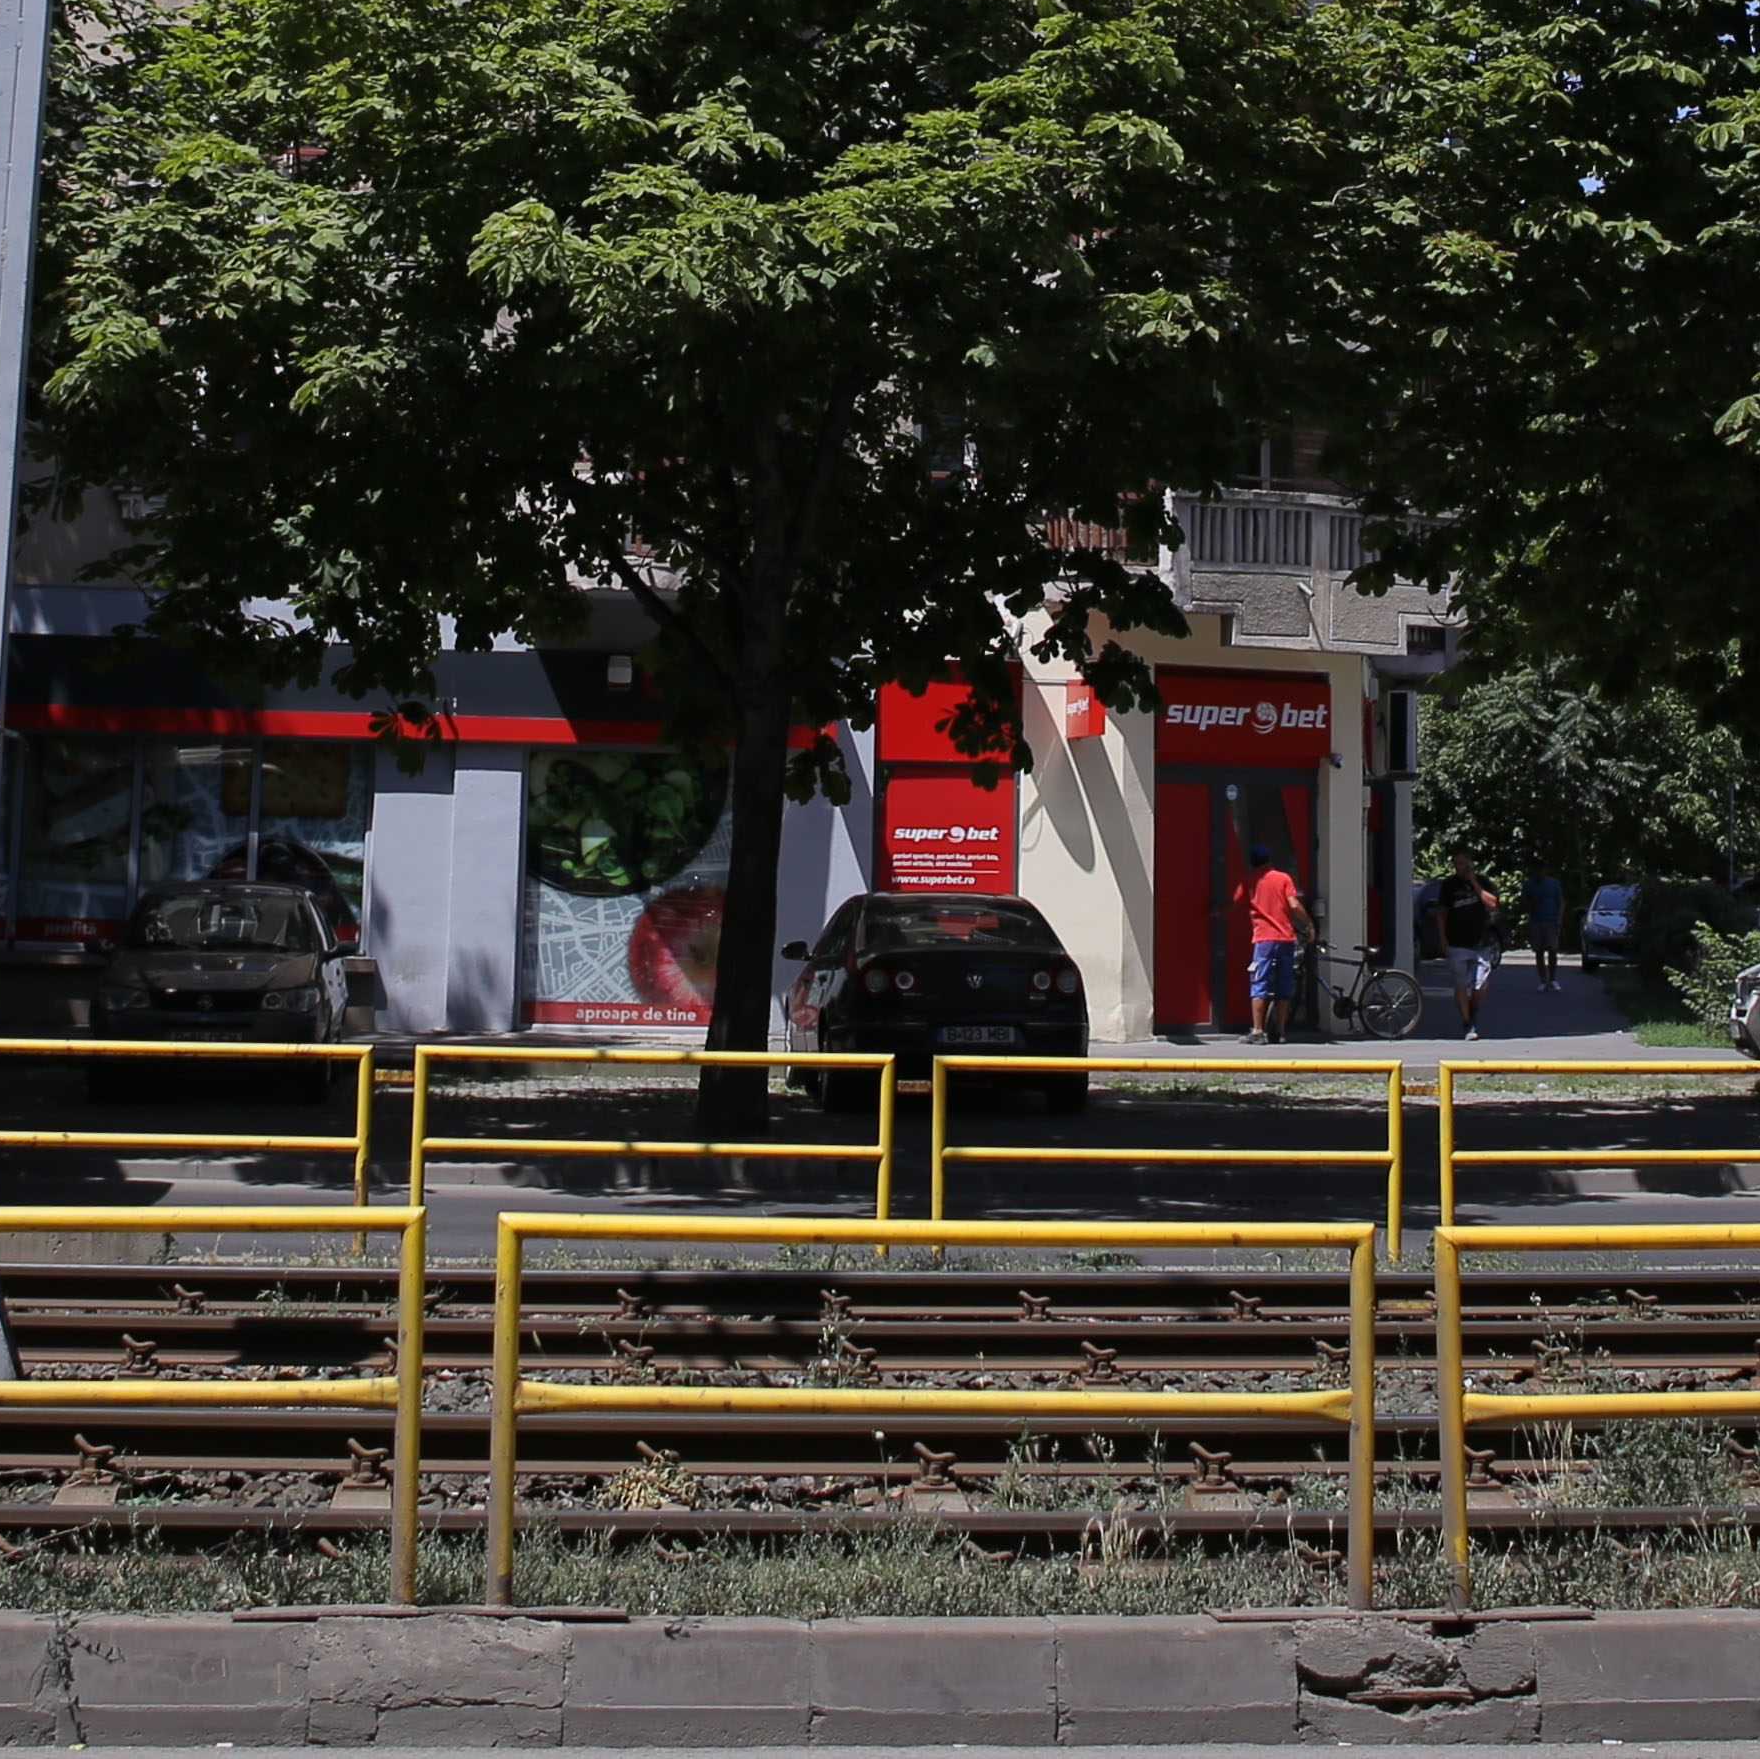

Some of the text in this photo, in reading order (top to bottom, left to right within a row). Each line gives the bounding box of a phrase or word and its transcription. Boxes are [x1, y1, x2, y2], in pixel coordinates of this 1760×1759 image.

[576, 1006, 697, 1023] aproape de tine
